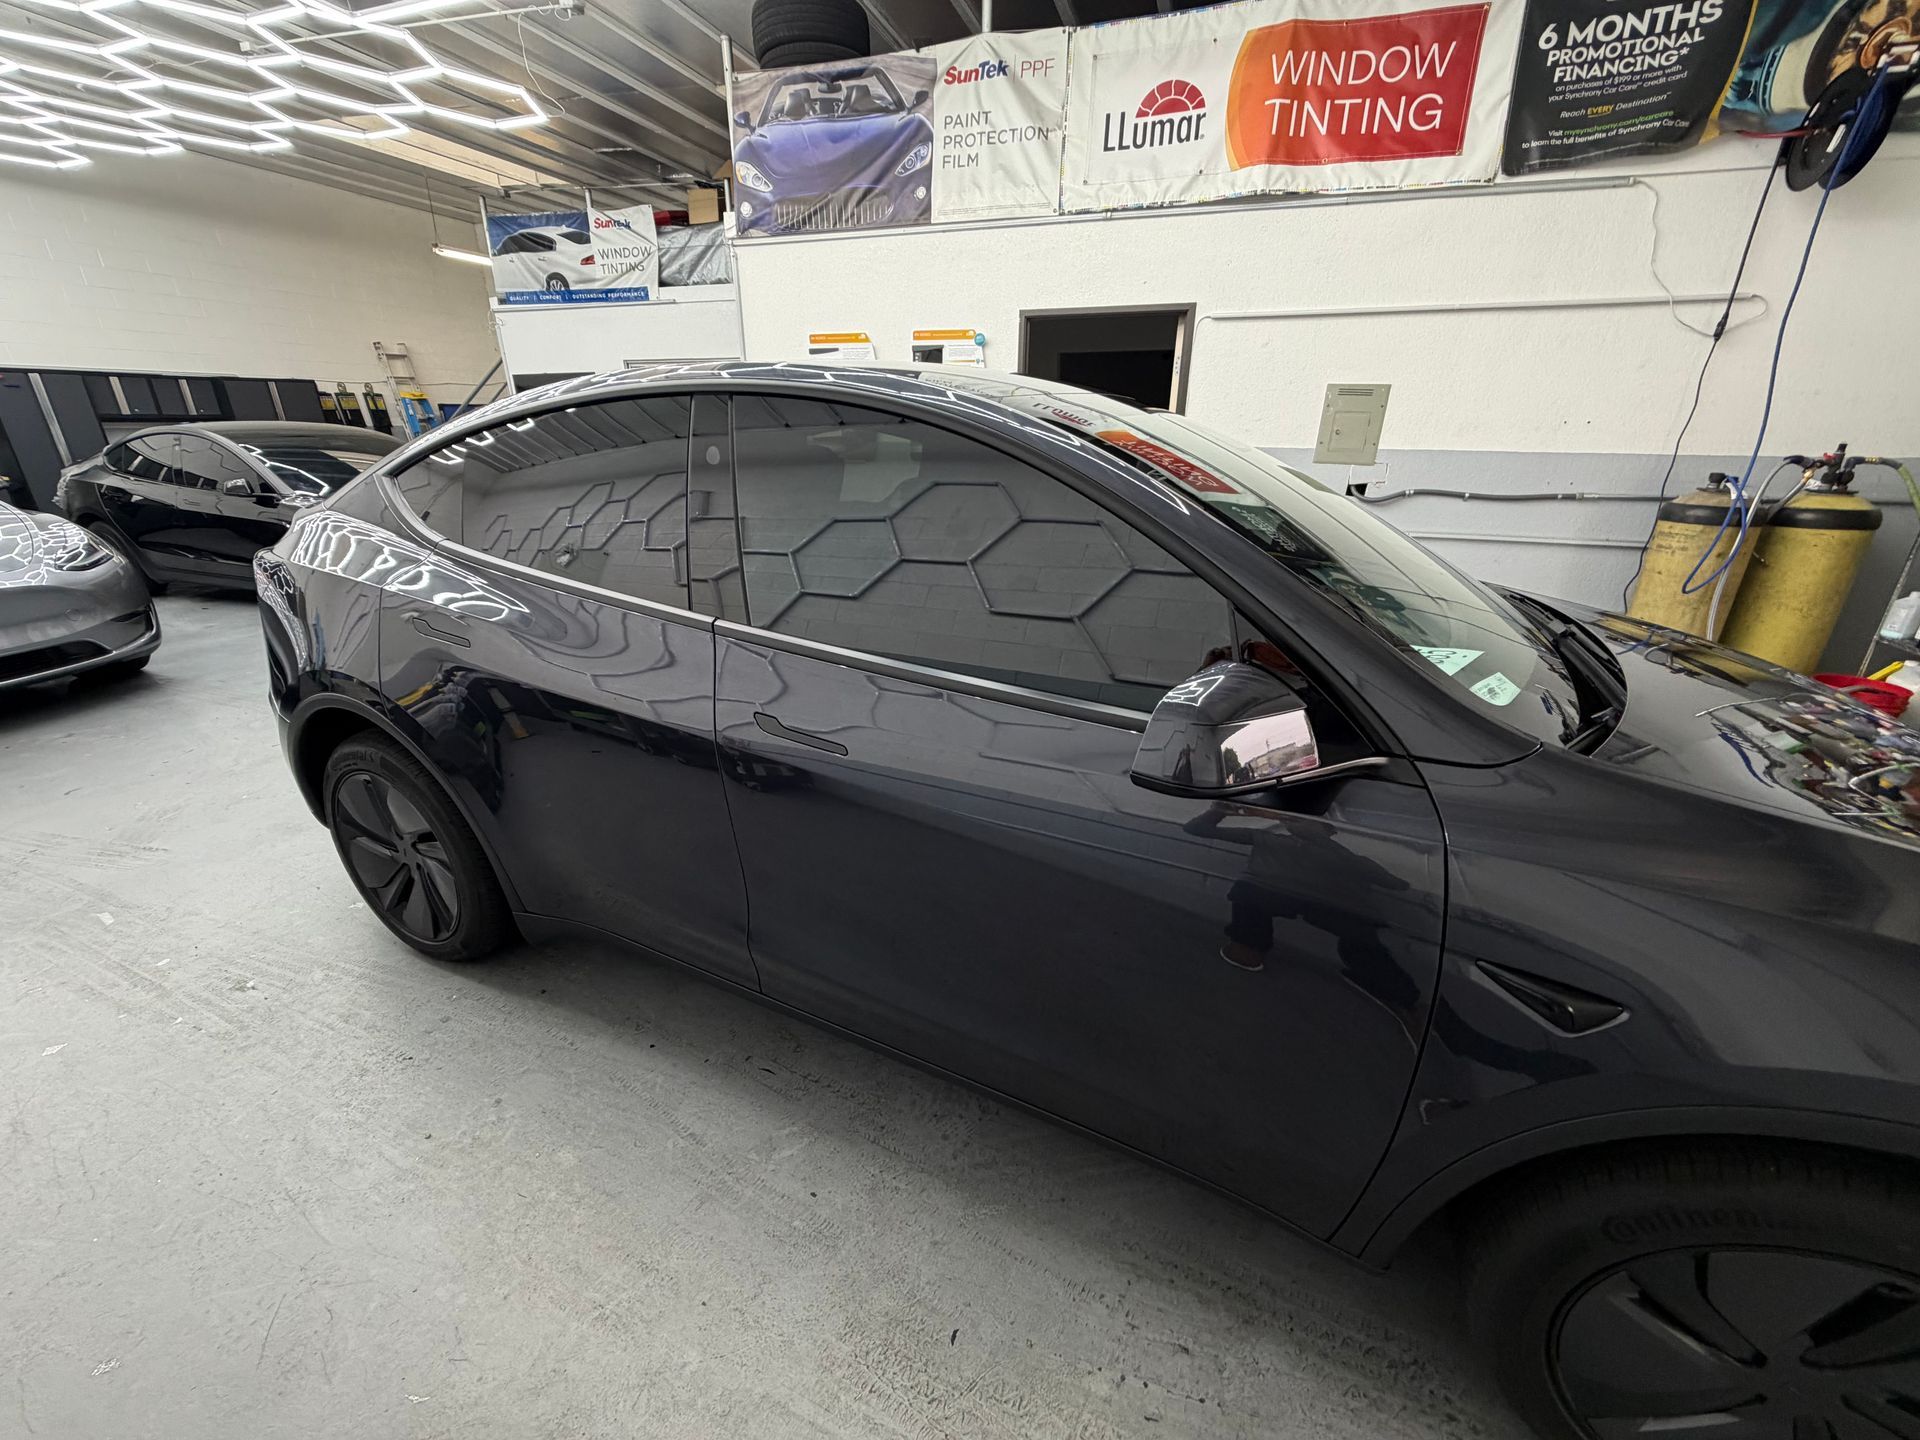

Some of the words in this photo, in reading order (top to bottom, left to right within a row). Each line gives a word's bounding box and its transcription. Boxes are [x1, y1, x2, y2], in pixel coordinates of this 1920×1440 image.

[1538, 23, 1557, 50] 6
[1567, 0, 1724, 47] MONTHS
[1546, 27, 1705, 67] PROMOTIONAL
[943, 59, 1009, 86] SunTek
[1021, 58, 1055, 79] PPF
[1271, 41, 1457, 86] WINDOW
[1548, 94, 1564, 103] your
[1565, 89, 1602, 100] Synchrony
[1603, 86, 1617, 95] Car
[1643, 78, 1666, 88] credit
[1668, 71, 1688, 82] card
[1555, 84, 1565, 92] on
[1566, 80, 1603, 92] purchases
[1604, 78, 1612, 86] of
[1614, 75, 1631, 86] $199
[1642, 70, 1663, 79] more
[1665, 64, 1682, 75] with
[943, 111, 992, 130] PAINT
[1264, 92, 1444, 138] TINTING
[1560, 109, 1586, 119] Reach
[1587, 104, 1614, 116] EVERY
[943, 126, 1049, 149] PROTECTION
[1103, 111, 1207, 153] LLumar
[1522, 141, 1530, 149] to
[1531, 137, 1549, 148] learn
[1550, 137, 1562, 146] the
[1563, 135, 1574, 145] full
[1575, 132, 1606, 144] benefits
[1608, 129, 1617, 137] of
[1617, 120, 1661, 135] Synchrony
[1662, 118, 1674, 127] Car
[1548, 129, 1563, 137] Visit
[942, 152, 979, 169] FILM
[598, 245, 652, 260] WINDOW
[600, 260, 645, 275] TINTING
